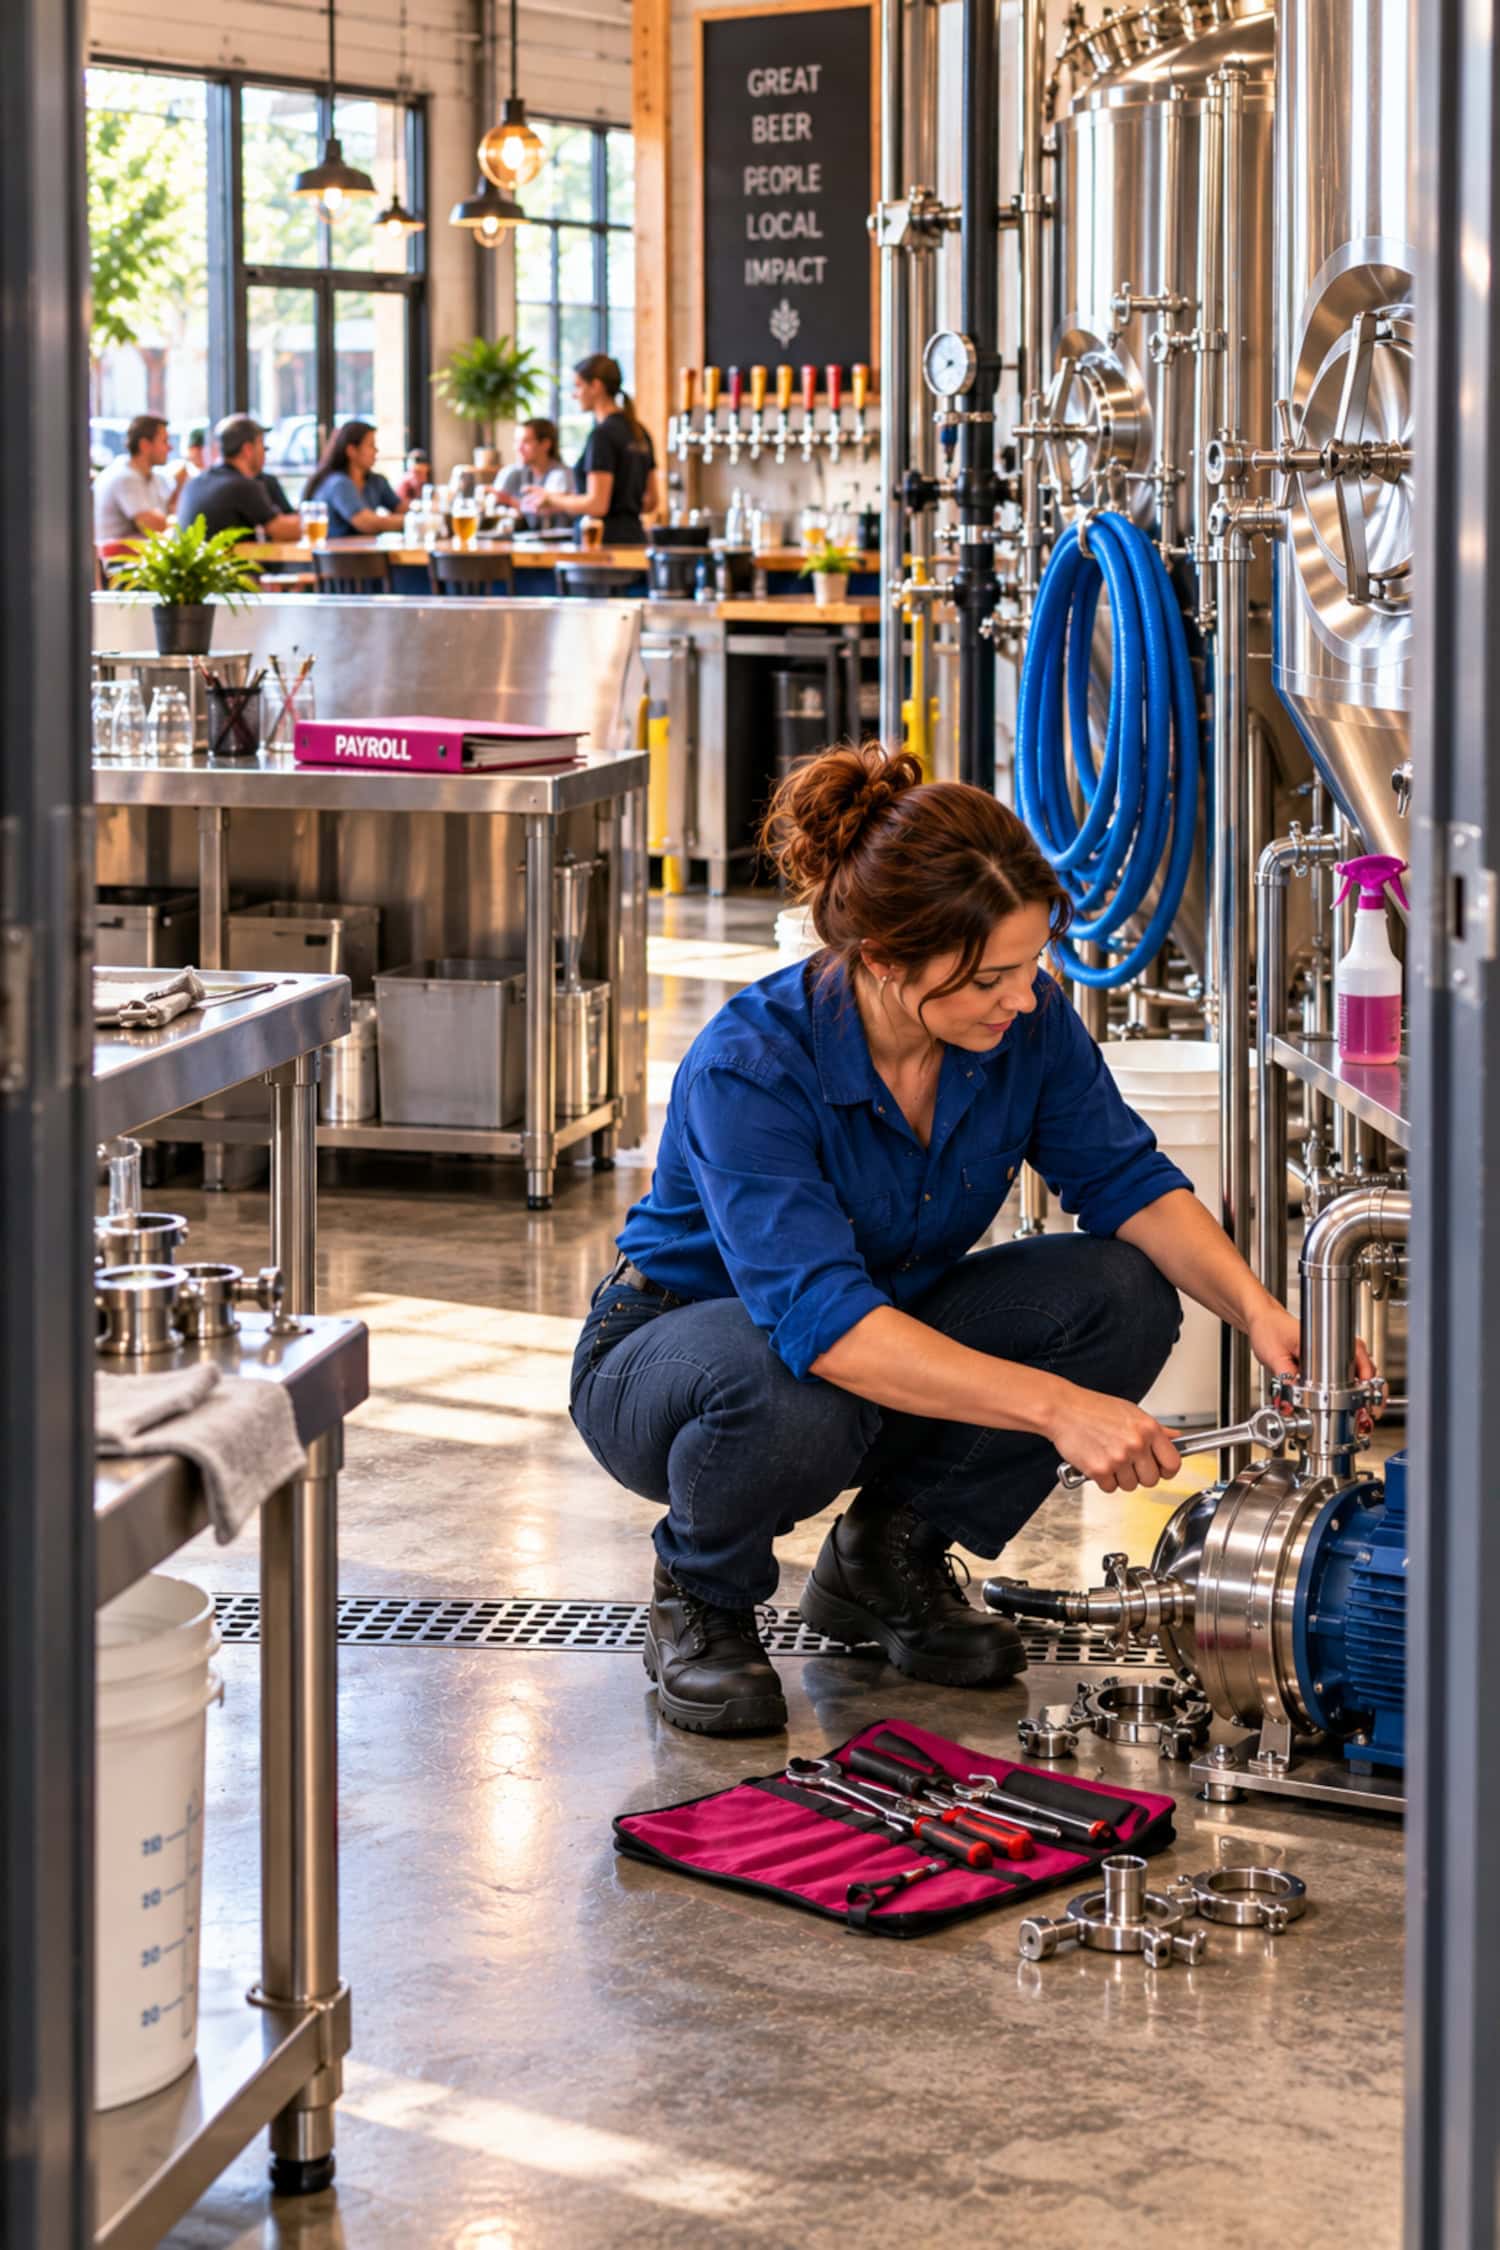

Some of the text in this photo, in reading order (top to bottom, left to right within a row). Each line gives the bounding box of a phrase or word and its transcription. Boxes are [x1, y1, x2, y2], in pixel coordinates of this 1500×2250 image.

[747, 65, 822, 97] GREAT
[752, 112, 812, 144] BEER
[744, 163, 822, 196] PEOPLE
[746, 211, 823, 241] LOCAL
[744, 256, 828, 286] IMPACT
[335, 734, 412, 760] PAYROLL
